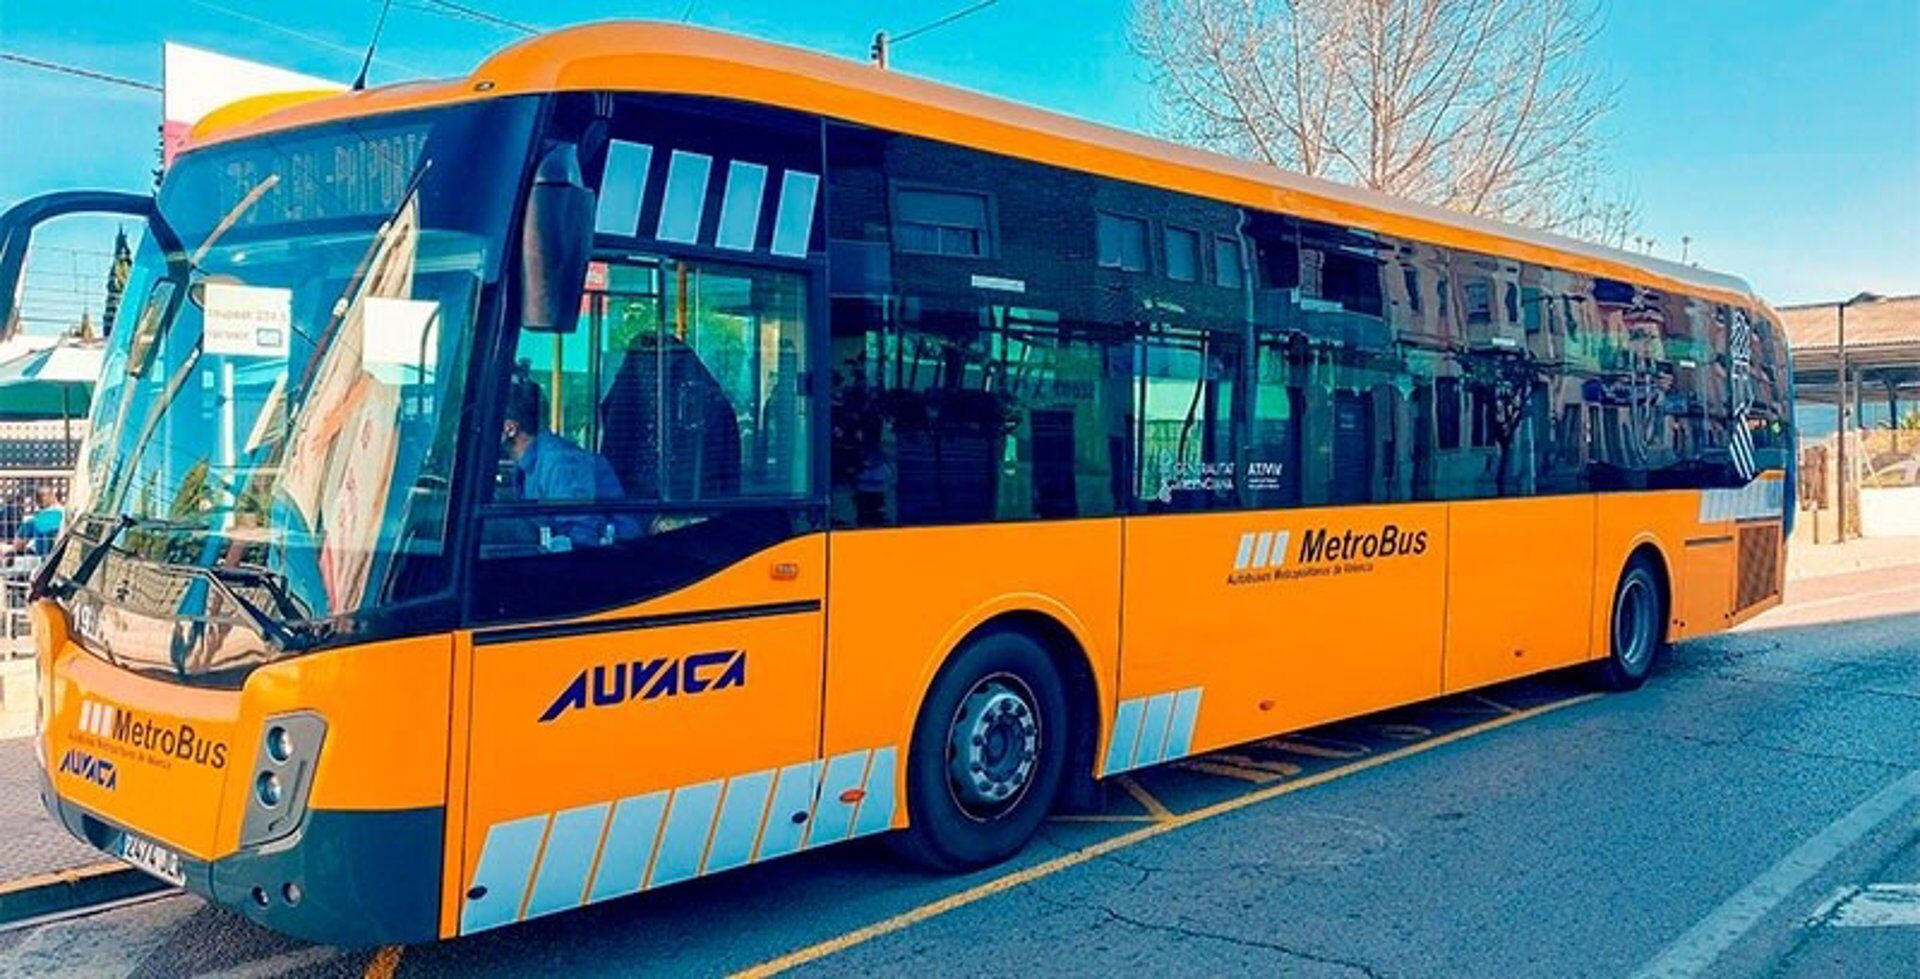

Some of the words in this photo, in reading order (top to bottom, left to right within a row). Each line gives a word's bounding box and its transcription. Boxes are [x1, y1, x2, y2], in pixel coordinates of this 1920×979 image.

[1299, 524, 1428, 563] MetroBus
[538, 651, 746, 723] AUVACA
[112, 709, 228, 769] MetroBus
[59, 749, 117, 791] AUVACA
